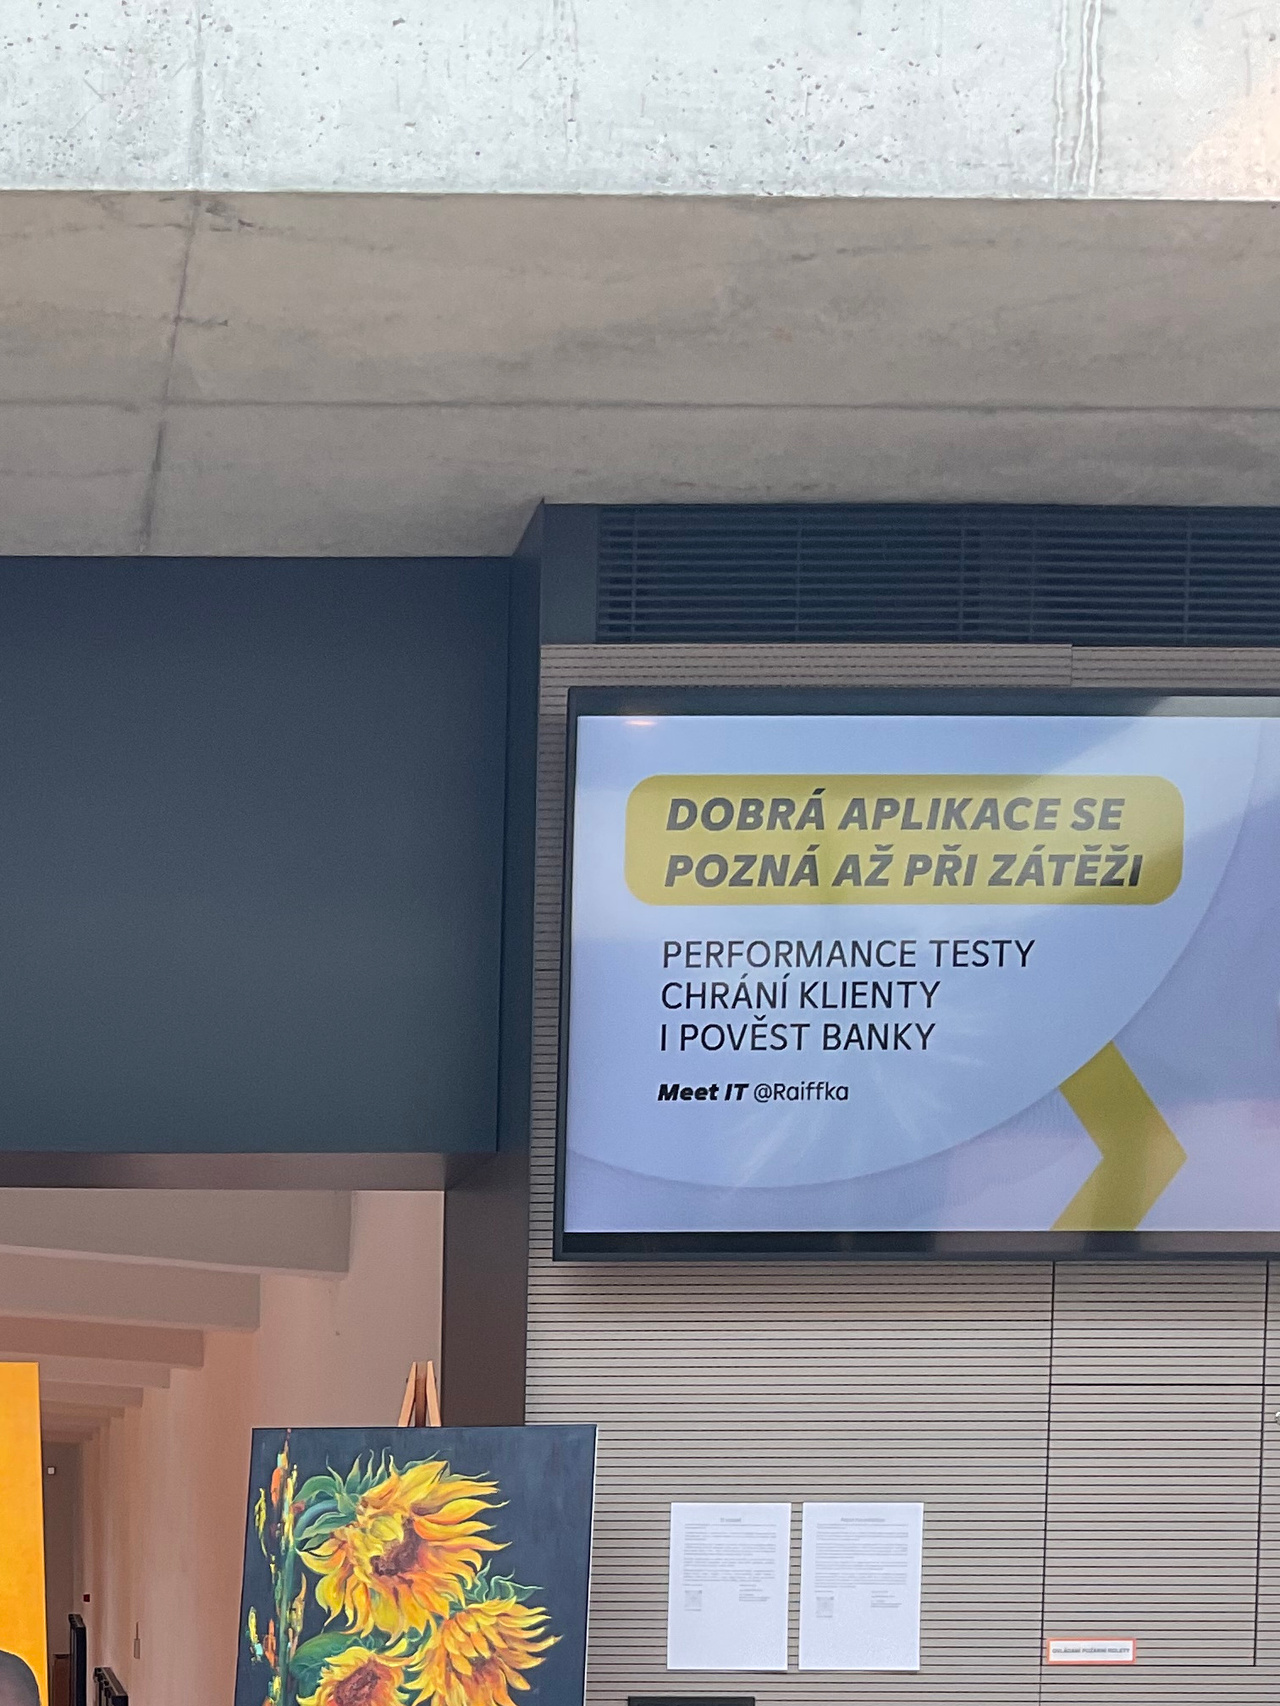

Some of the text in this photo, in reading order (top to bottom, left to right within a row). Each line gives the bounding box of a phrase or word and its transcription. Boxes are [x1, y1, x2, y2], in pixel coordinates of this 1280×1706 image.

[666, 787, 1125, 831] DOBRÁ APLIKACE SE
[665, 843, 1143, 888] POZNÁ AŽ PŘI ZÁTĚŽI
[662, 940, 1035, 969] PERFORMANCE TESTY
[661, 973, 941, 1010] CHRÁNÍ KLIENTY
[660, 1014, 936, 1051] I POVĚST BANKY
[657, 1081, 849, 1102] Meet IT @Raiffka
